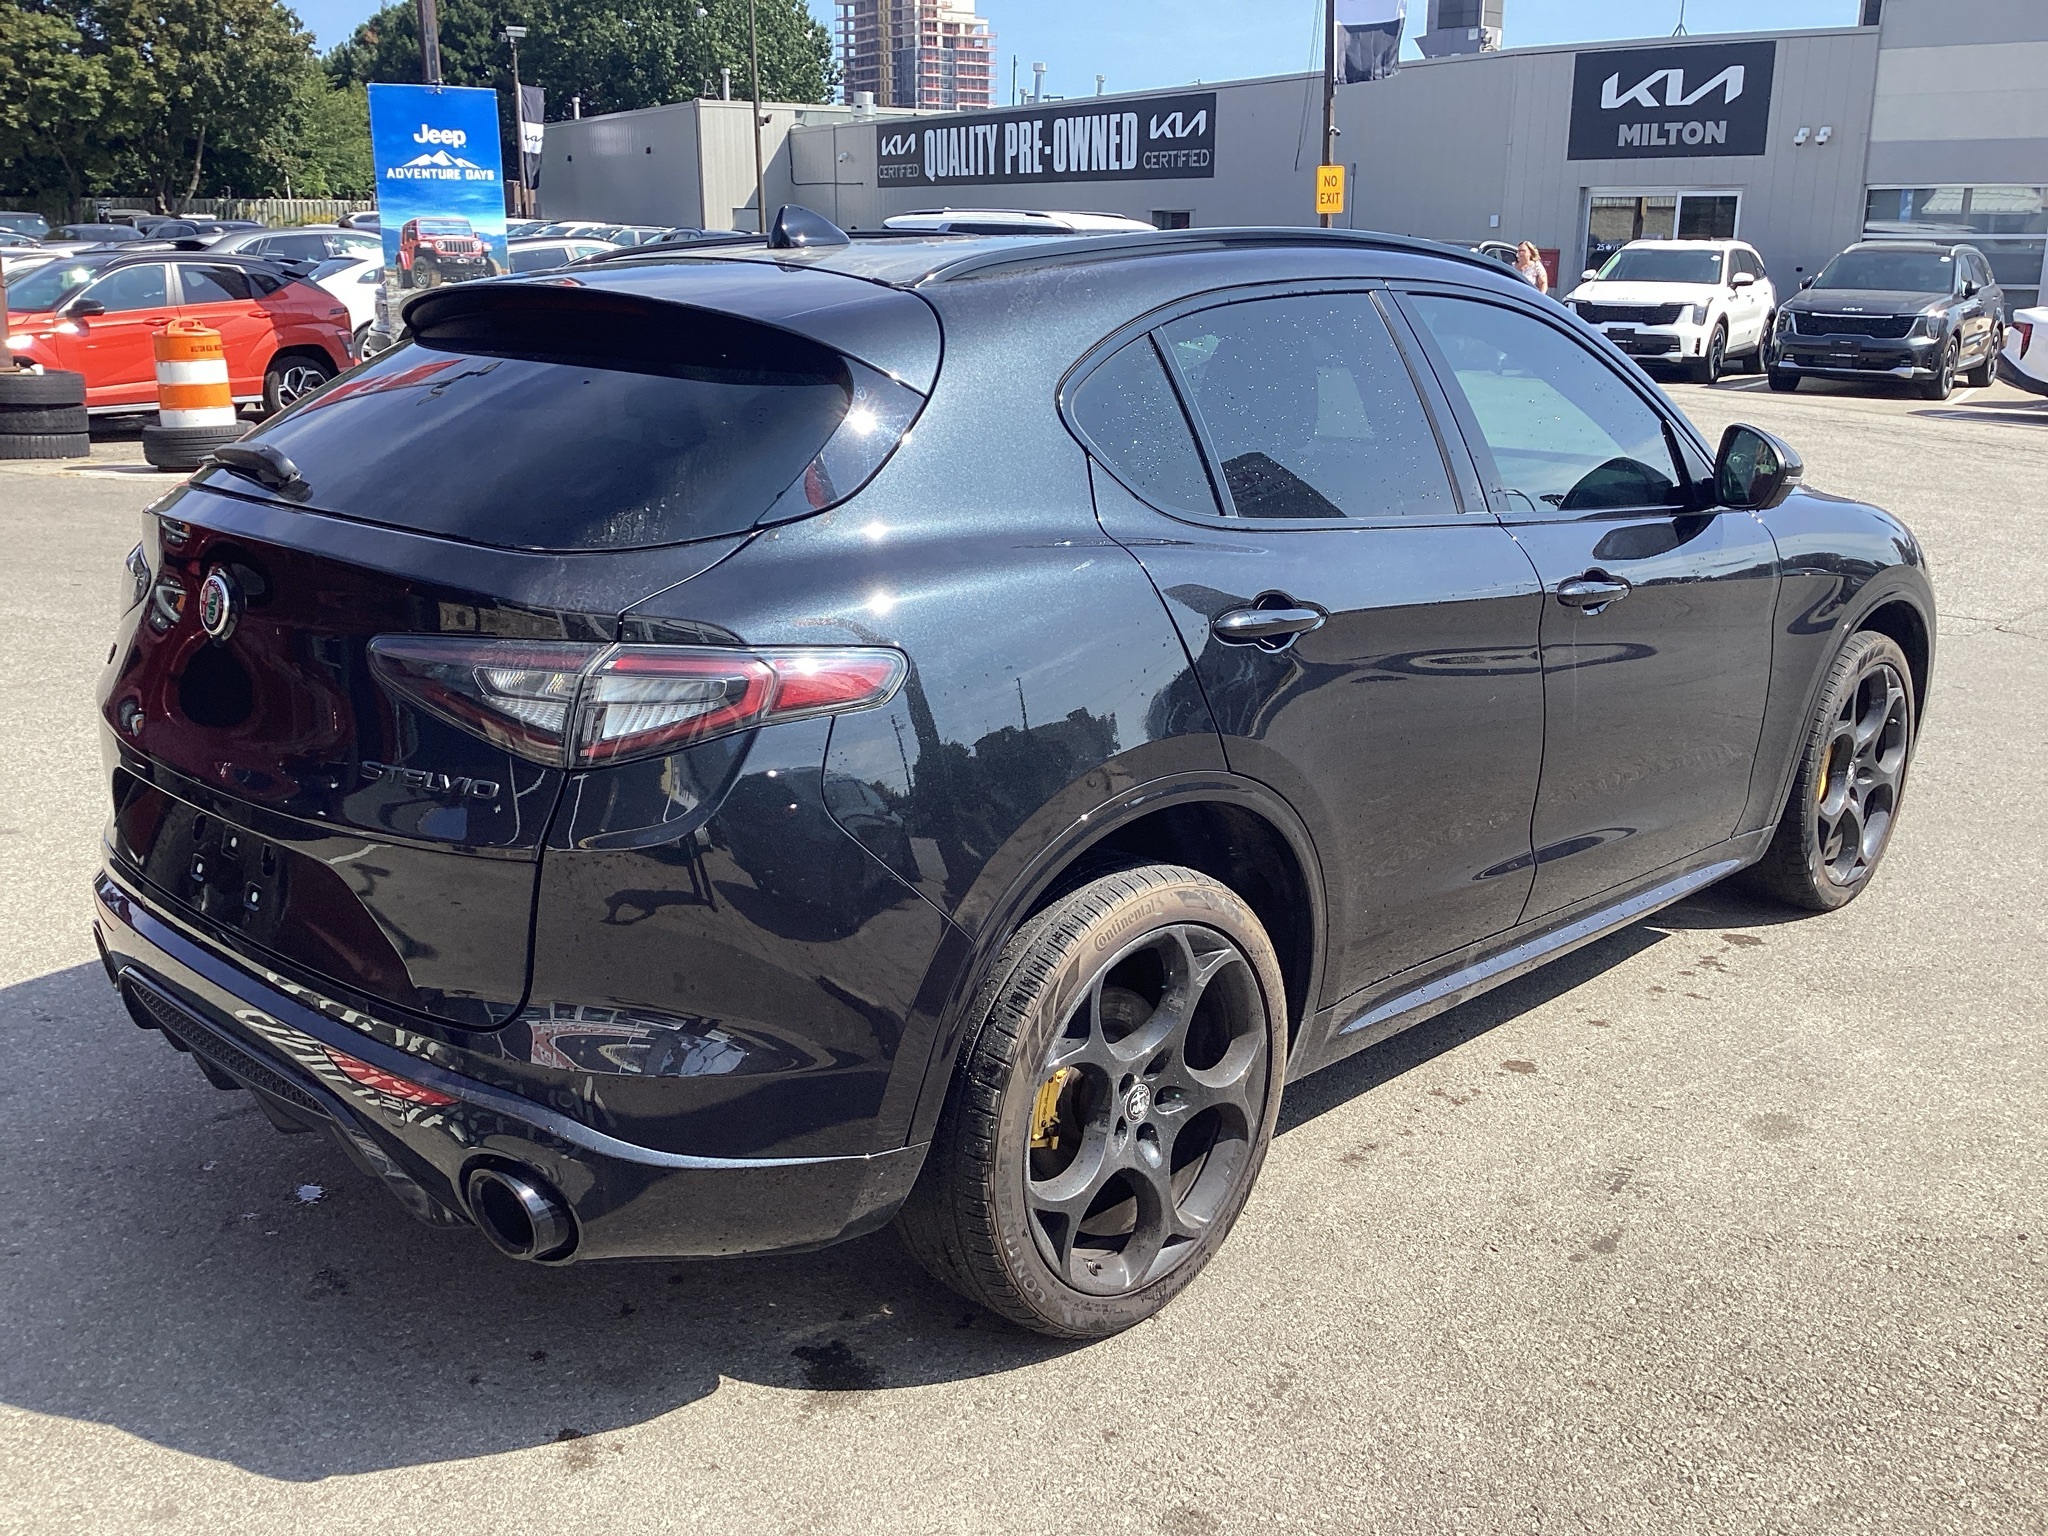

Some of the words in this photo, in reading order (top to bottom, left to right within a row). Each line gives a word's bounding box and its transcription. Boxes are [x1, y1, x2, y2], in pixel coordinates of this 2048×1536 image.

[1600, 65, 1745, 109] KIA
[413, 123, 467, 149] Jeep
[1149, 110, 1207, 140] KIA
[1617, 120, 1728, 147] MILTON
[881, 133, 916, 156] KIA
[923, 124, 998, 182] QUALITY
[1004, 112, 1139, 175] PRE-OWNED
[878, 163, 920, 179] CERTIFIED
[1142, 149, 1212, 169] CERTIFIED
[386, 167, 462, 180] ADVENTURE
[465, 169, 495, 181] DAYS
[1323, 175, 1338, 188] NO
[1320, 192, 1341, 205] EXIT
[360, 760, 500, 799] STELVIO
[1094, 897, 1156, 952] Continental
